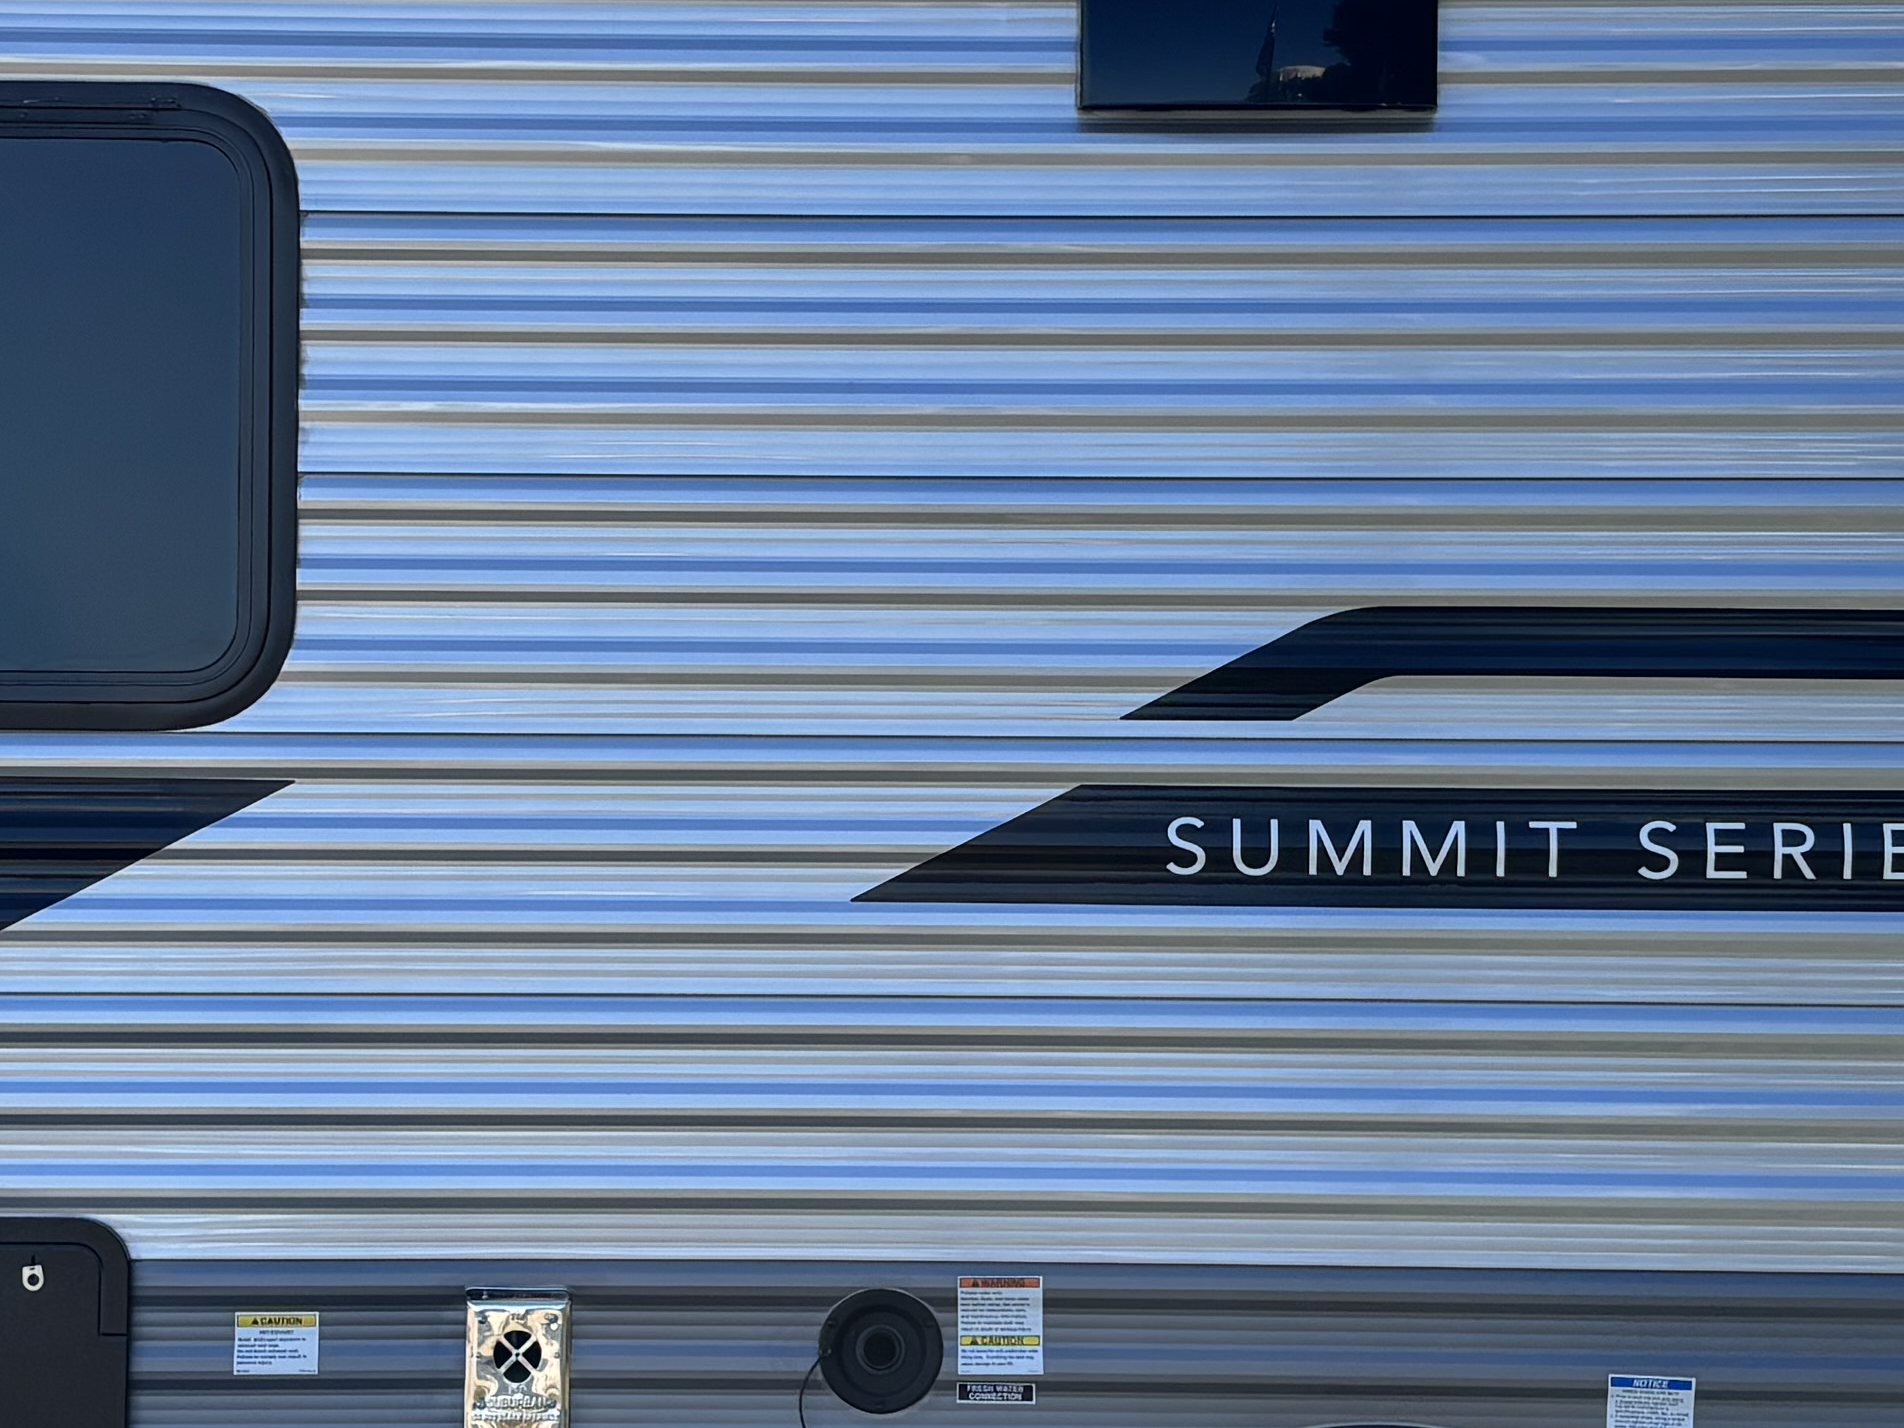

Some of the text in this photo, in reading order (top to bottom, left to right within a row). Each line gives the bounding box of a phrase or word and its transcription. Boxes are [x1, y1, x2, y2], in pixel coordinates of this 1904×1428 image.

[1164, 816, 1578, 879] SUMMIT
[260, 1316, 303, 1326] CAUTION
[982, 1336, 1024, 1345] CAUTION
[966, 1383, 1024, 1393] FRESH WATER
[1632, 1379, 1669, 1389] NOTICE
[968, 1392, 1022, 1401] CONNECTION
